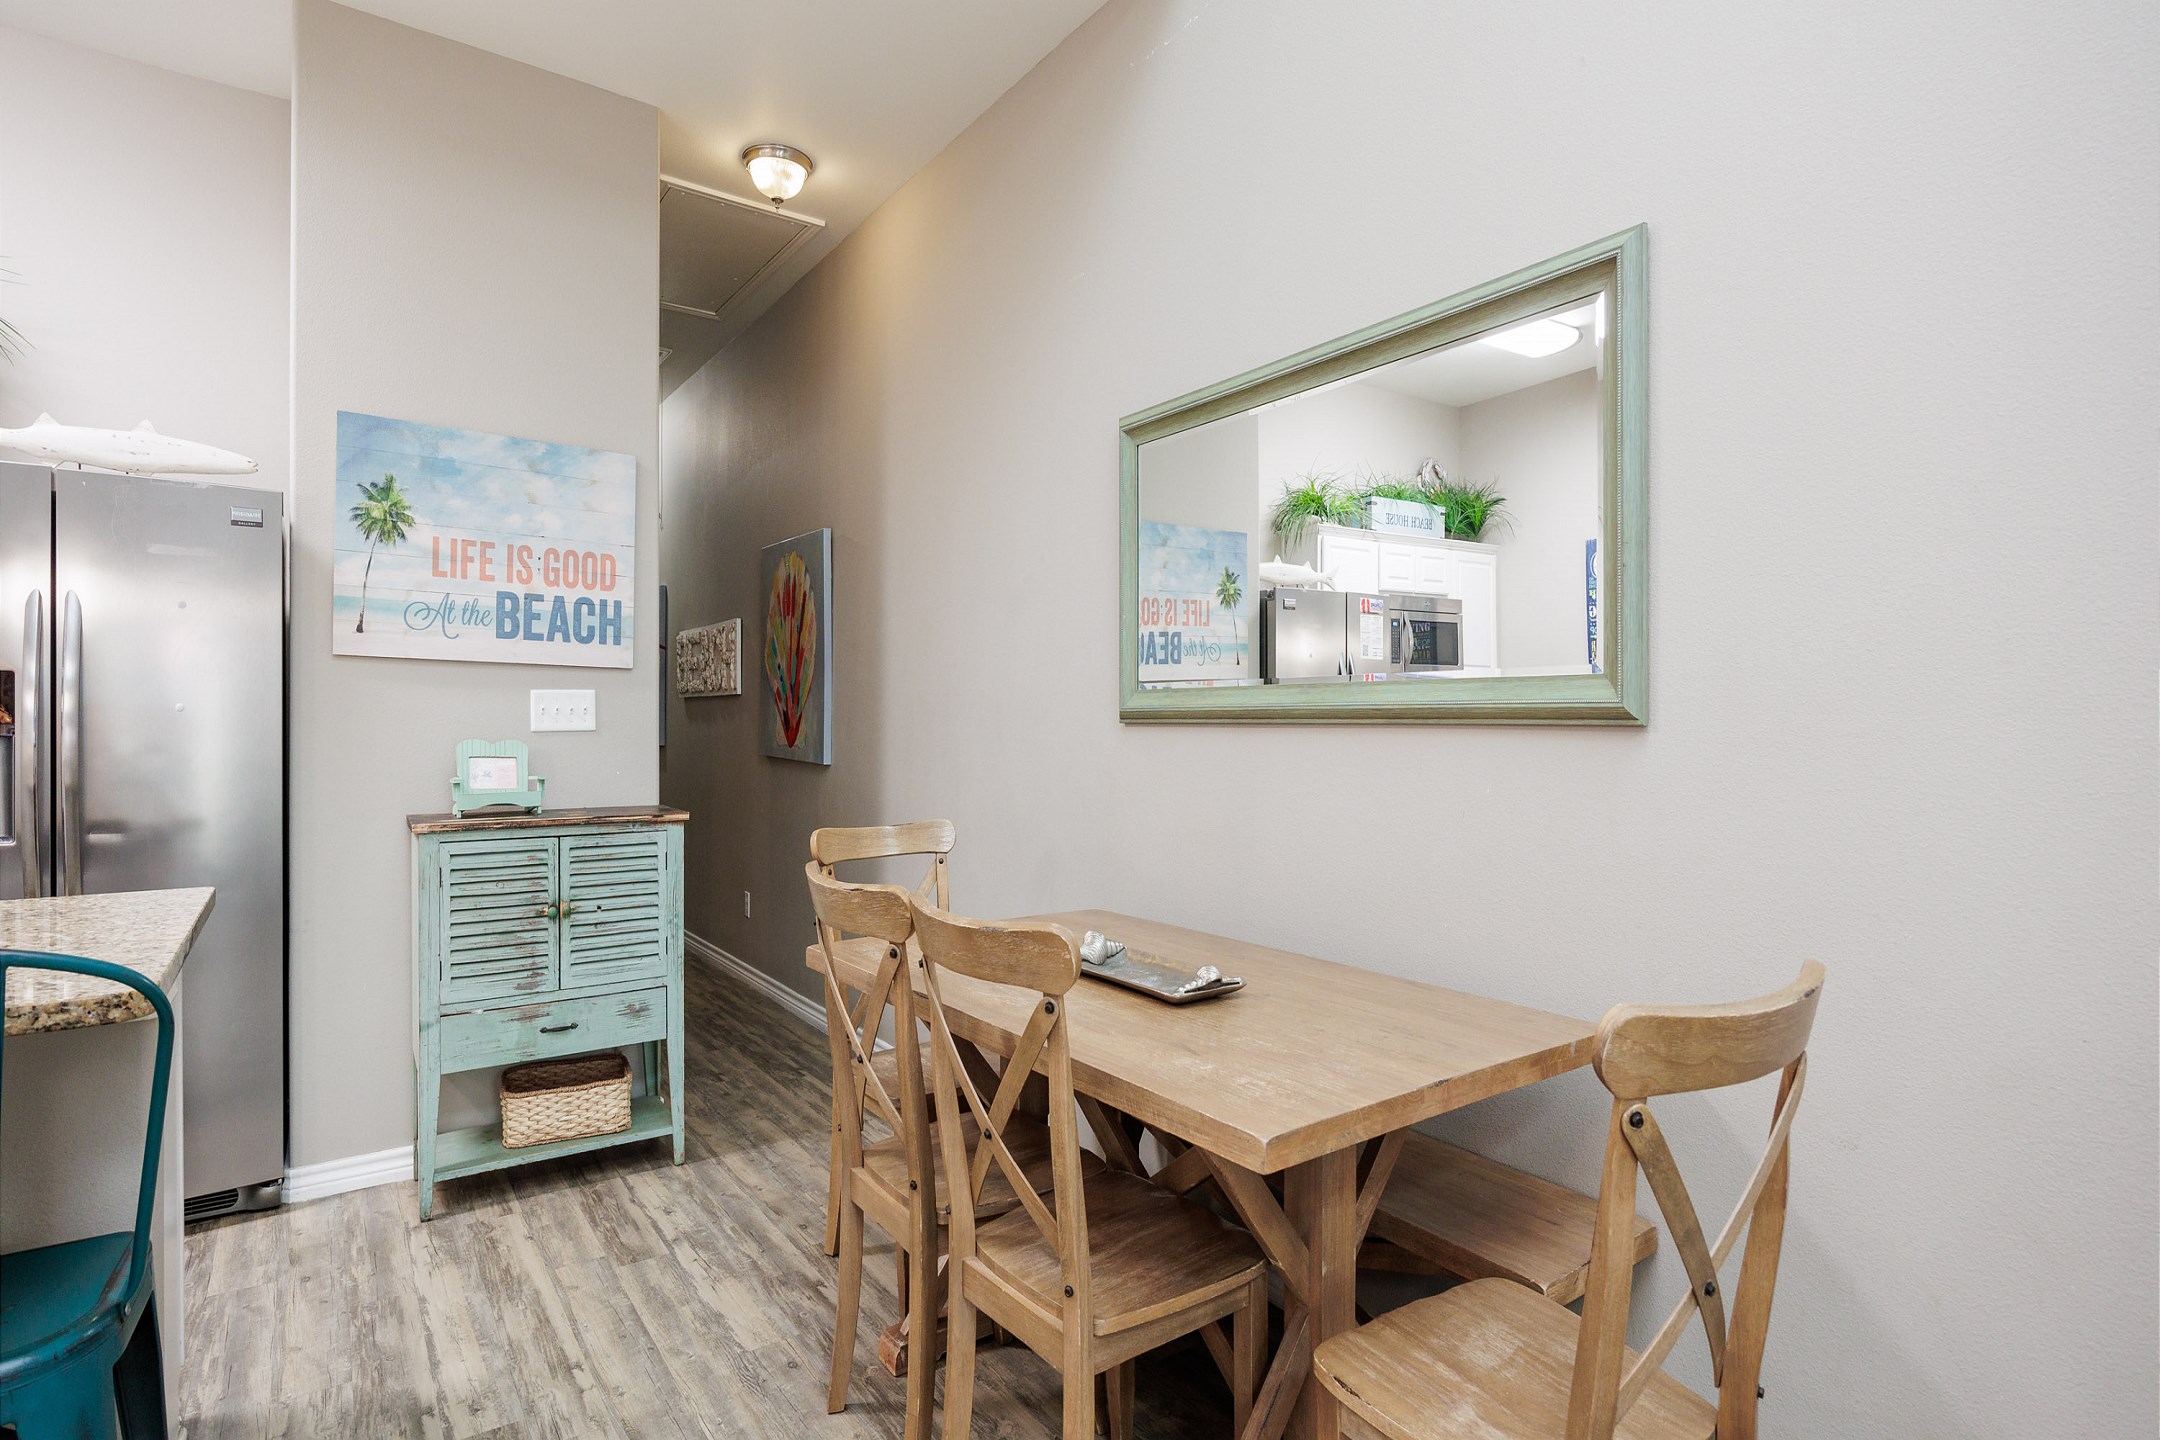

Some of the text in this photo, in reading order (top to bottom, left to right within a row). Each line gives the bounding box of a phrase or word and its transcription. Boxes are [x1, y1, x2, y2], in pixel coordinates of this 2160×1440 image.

[432, 536, 616, 591] LIFE IS GOOD
[404, 590, 622, 645] At the BEACH
